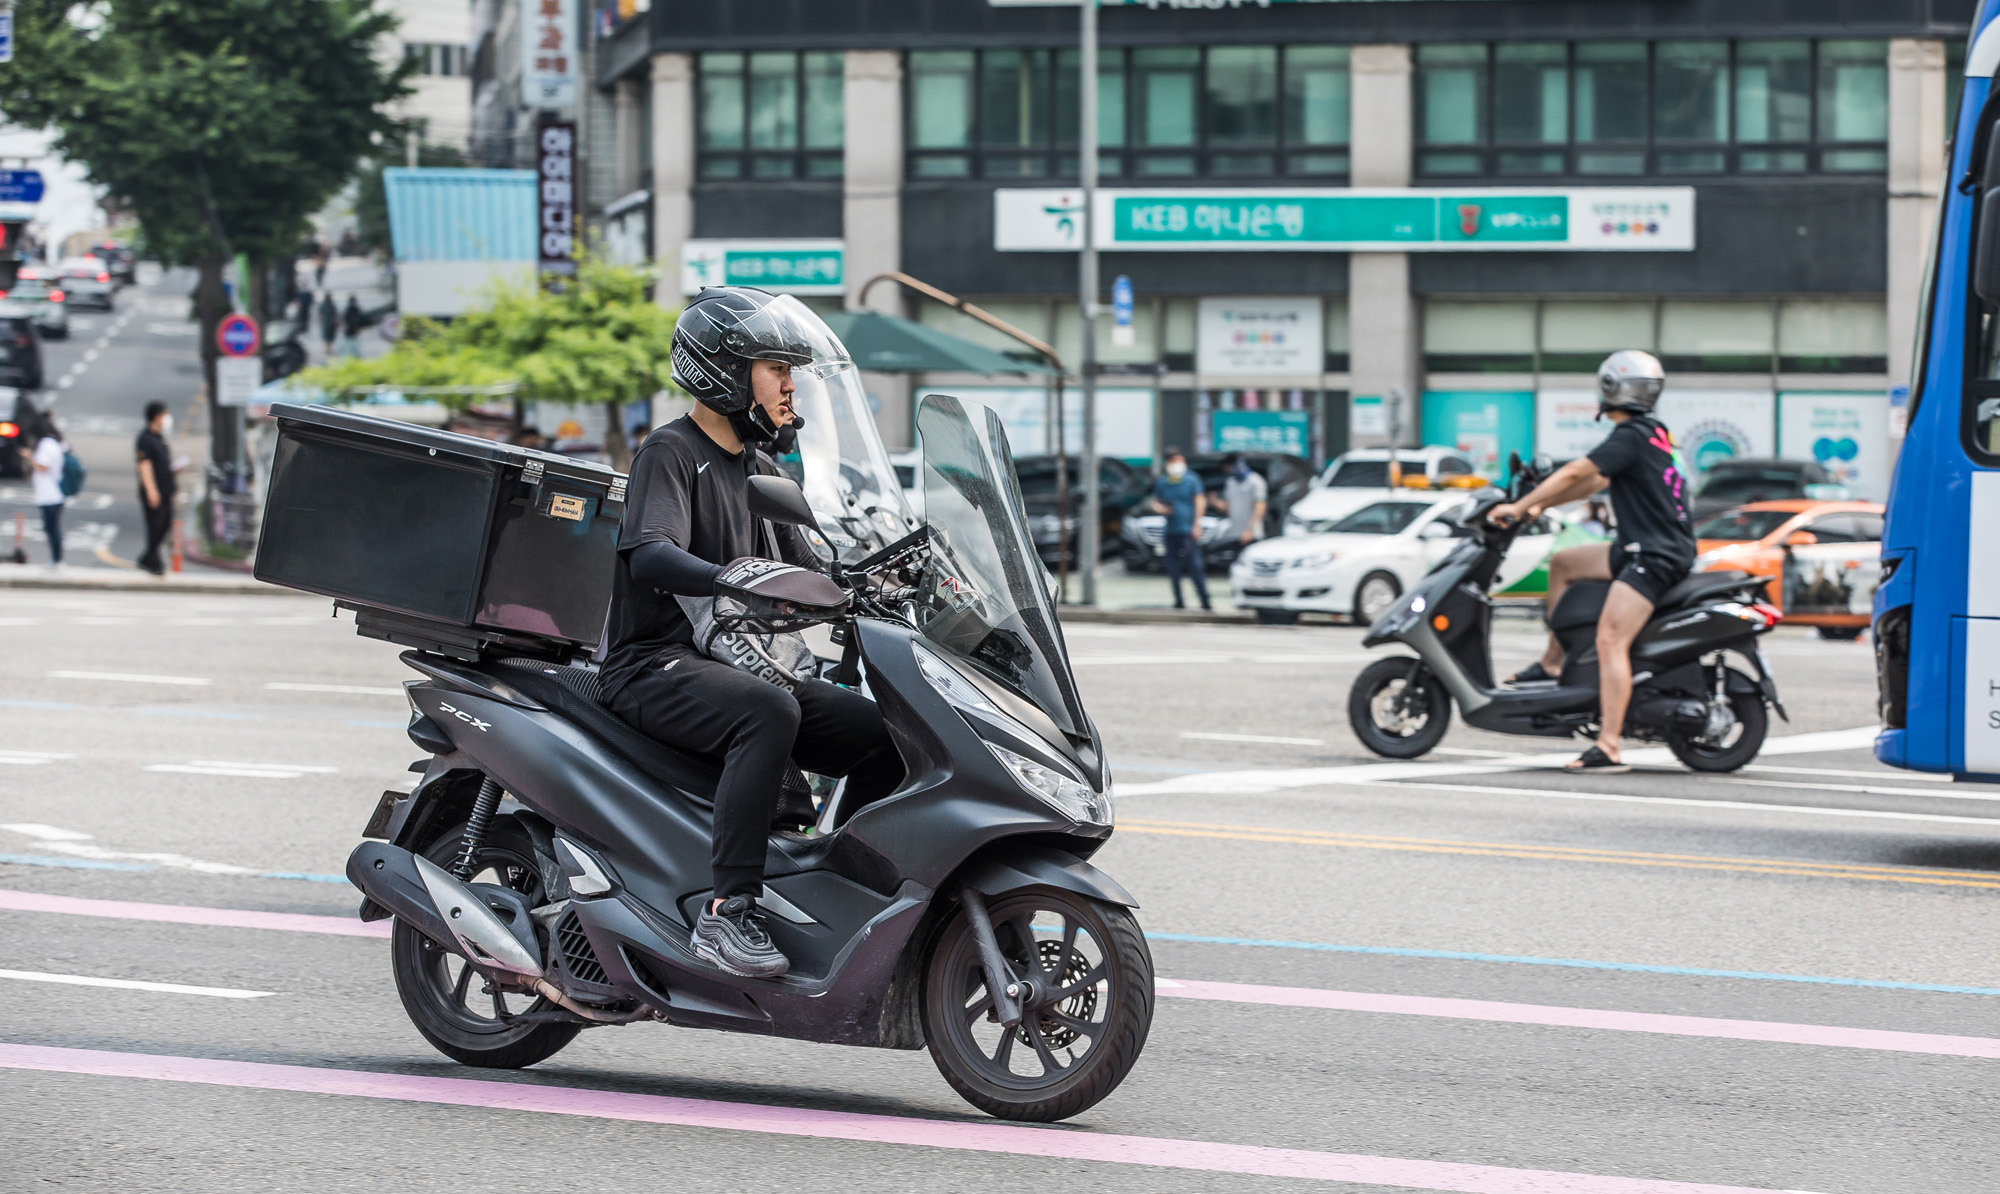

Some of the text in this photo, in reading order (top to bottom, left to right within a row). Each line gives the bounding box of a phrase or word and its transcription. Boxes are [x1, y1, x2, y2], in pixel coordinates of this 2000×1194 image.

[1131, 203, 1304, 238] KEB 하나은행
[674, 342, 705, 385] GRAVITY
[439, 701, 492, 732] PCX
